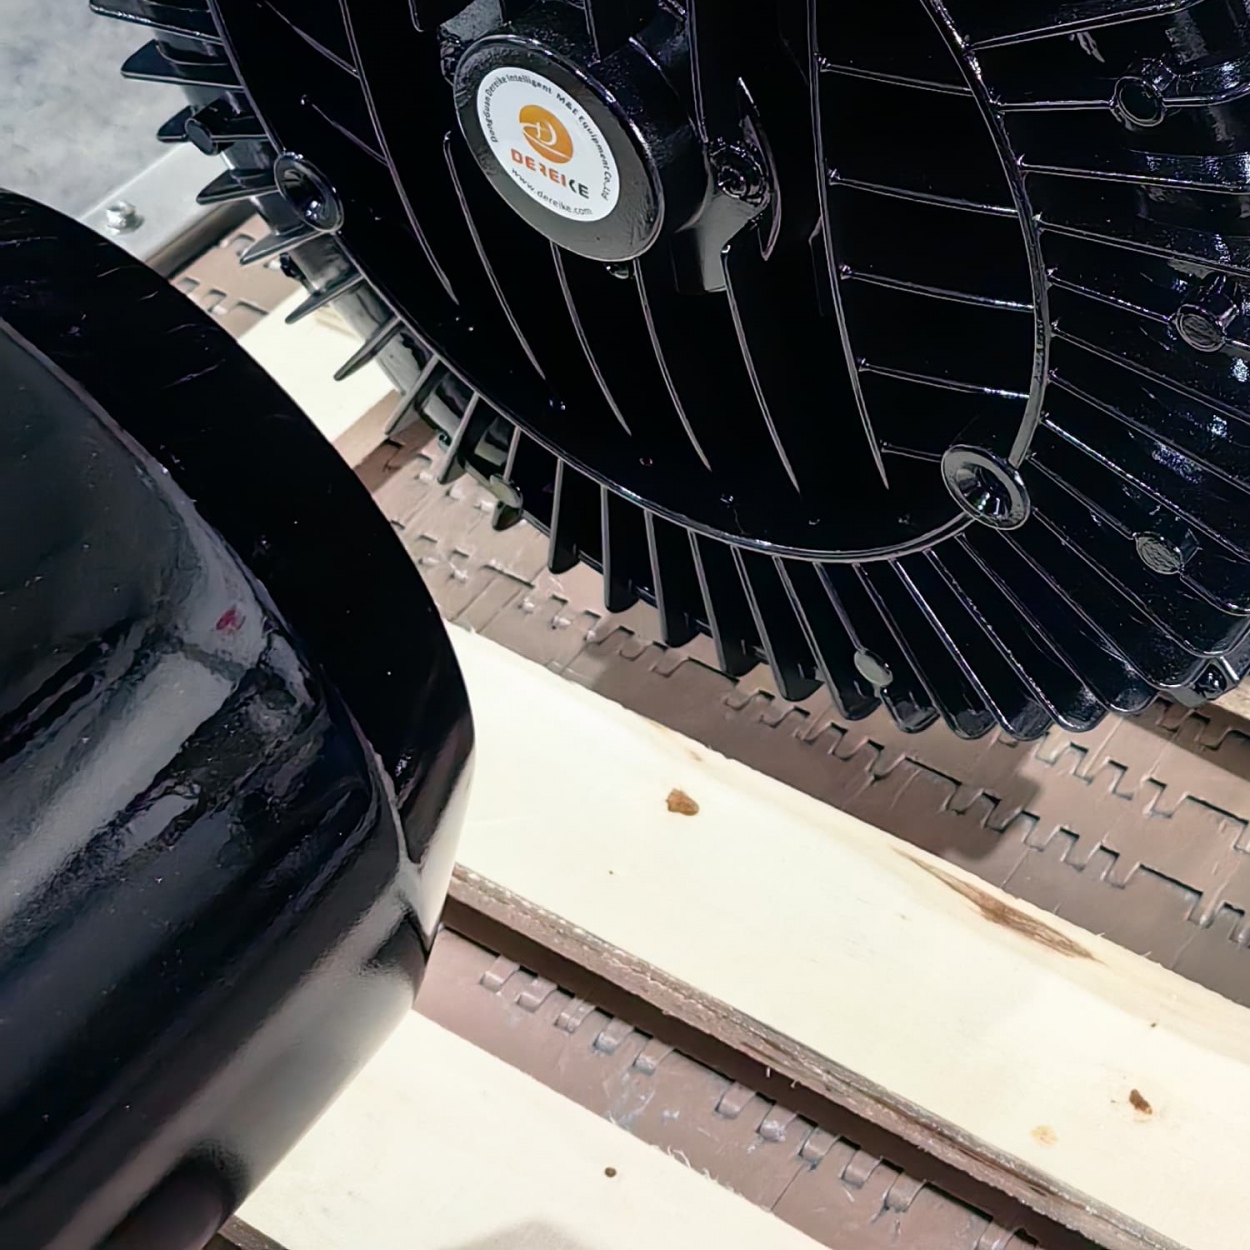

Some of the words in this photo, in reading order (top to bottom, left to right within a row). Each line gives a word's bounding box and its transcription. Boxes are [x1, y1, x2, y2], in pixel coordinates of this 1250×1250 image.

[485, 76, 507, 97] Dereike
[506, 74, 552, 94] Intelligent
[556, 93, 578, 116] M&E
[578, 115, 610, 170] Equipment
[511, 148, 589, 200] DEREIKE
[512, 168, 593, 215] www.dereike.com
